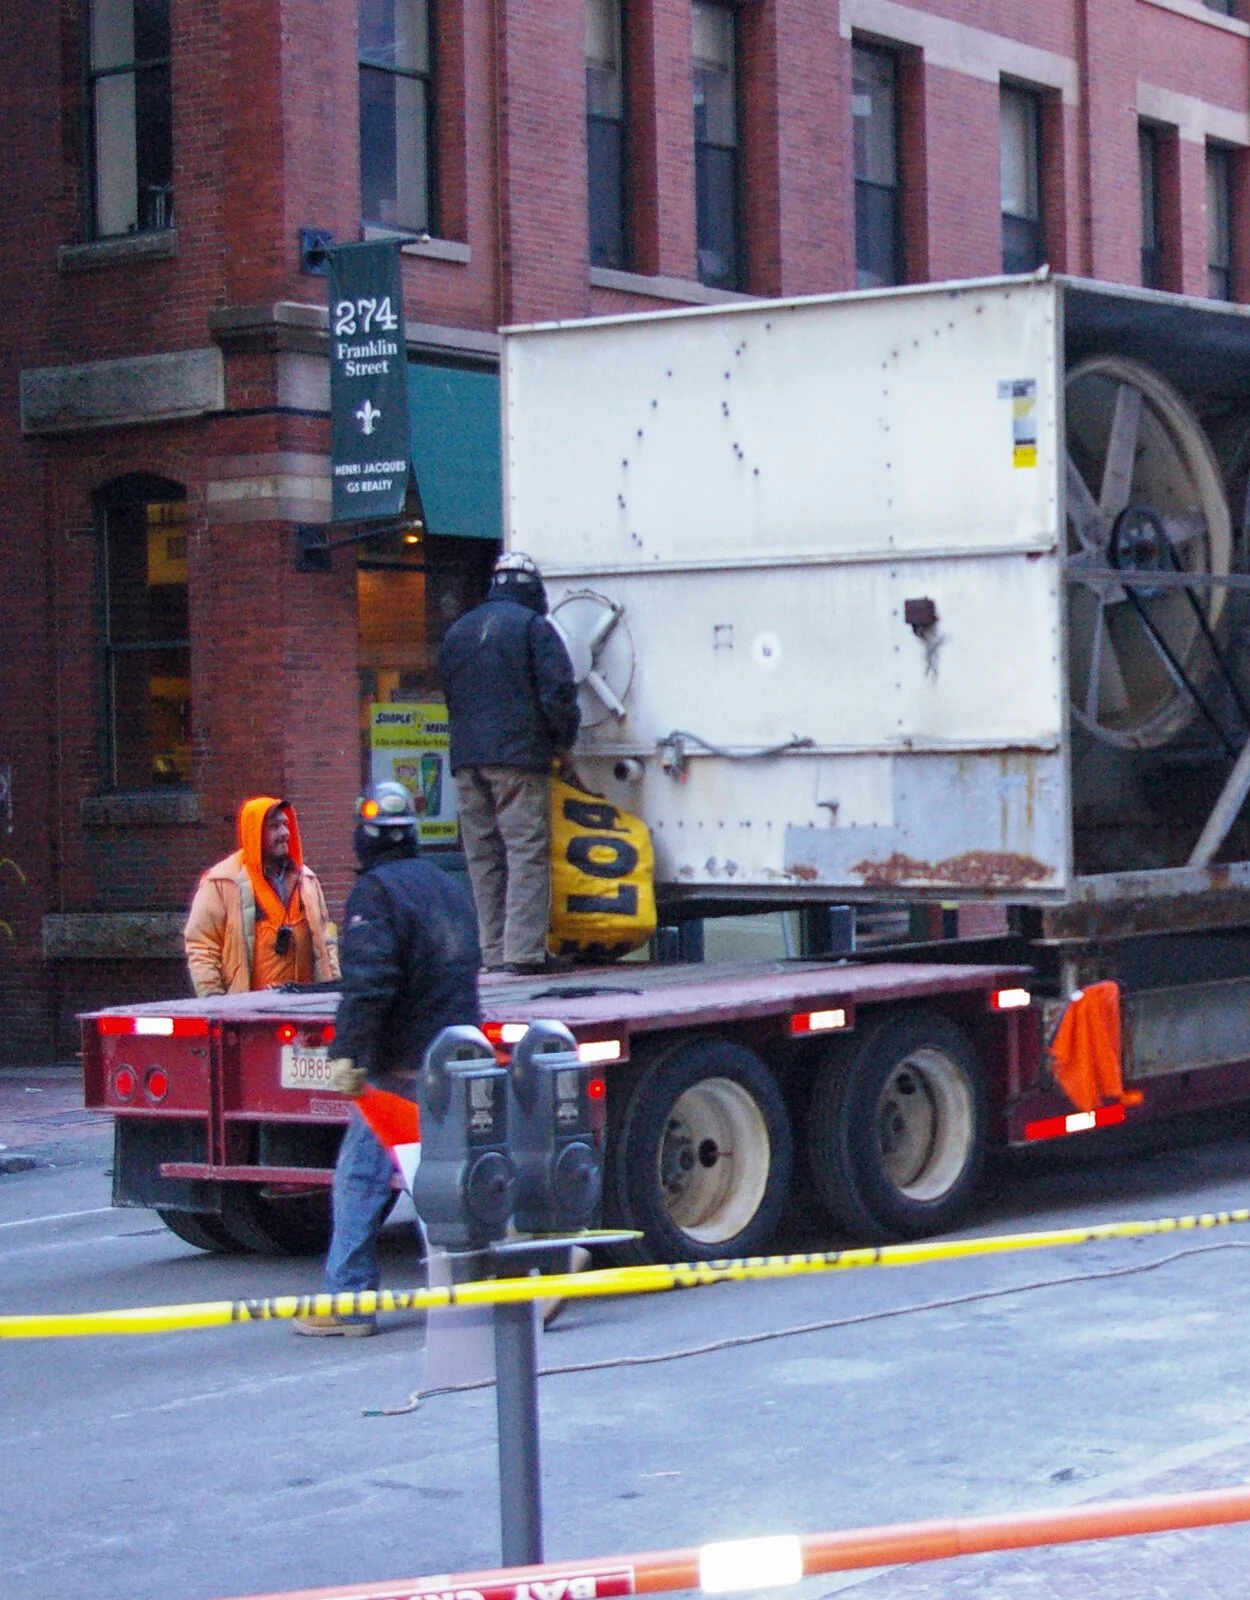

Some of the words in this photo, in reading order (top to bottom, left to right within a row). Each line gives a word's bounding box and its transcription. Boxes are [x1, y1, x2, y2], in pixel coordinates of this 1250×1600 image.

[336, 296, 398, 336] 274
[337, 339, 398, 359] Franklin
[345, 360, 389, 376] Street
[335, 464, 361, 475] HENRI
[363, 460, 406, 474] JACQUES
[362, 480, 393, 492] REALTY
